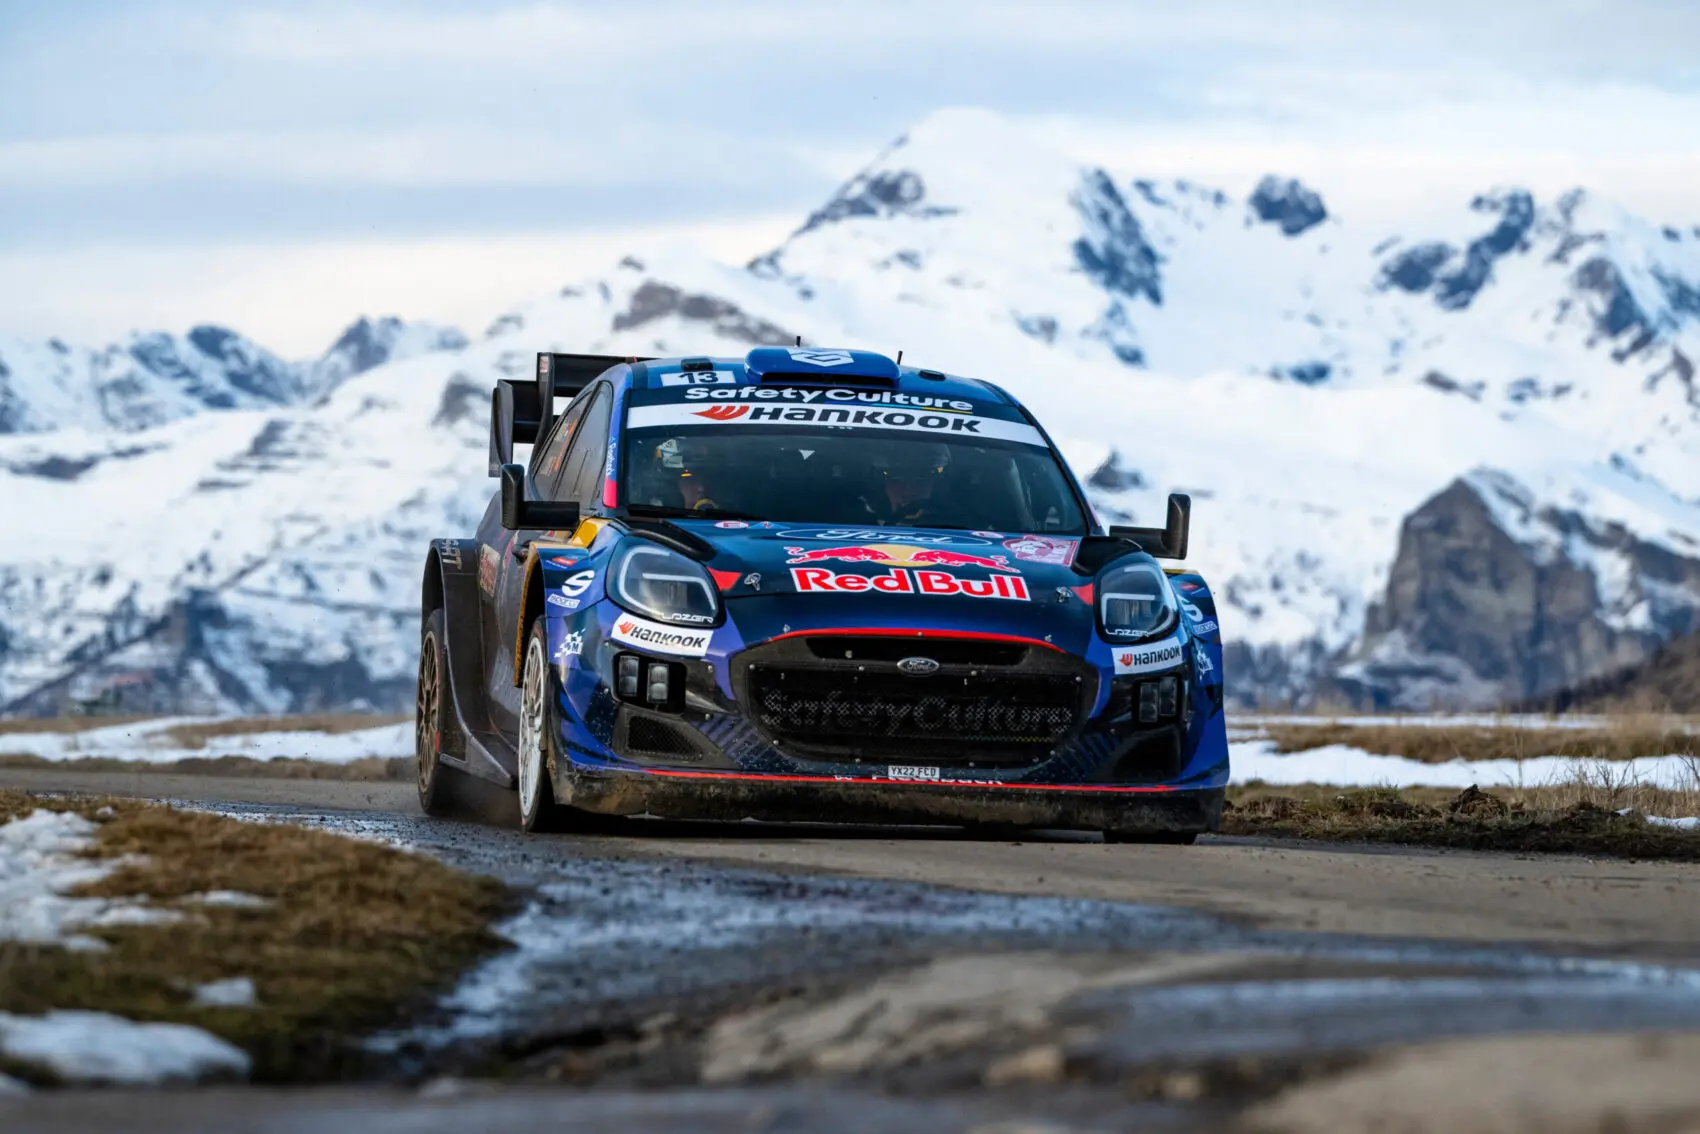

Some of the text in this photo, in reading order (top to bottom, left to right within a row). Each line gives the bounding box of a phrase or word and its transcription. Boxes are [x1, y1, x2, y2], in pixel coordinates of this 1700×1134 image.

[679, 372, 719, 384] 13
[684, 386, 974, 411] SafetyCulture
[815, 529, 954, 545] Ford
[790, 568, 1032, 601] Red Bull
[906, 659, 936, 672] Ford
[761, 689, 1073, 737] SafetyCulture
[891, 767, 937, 777] YX22 FCD
